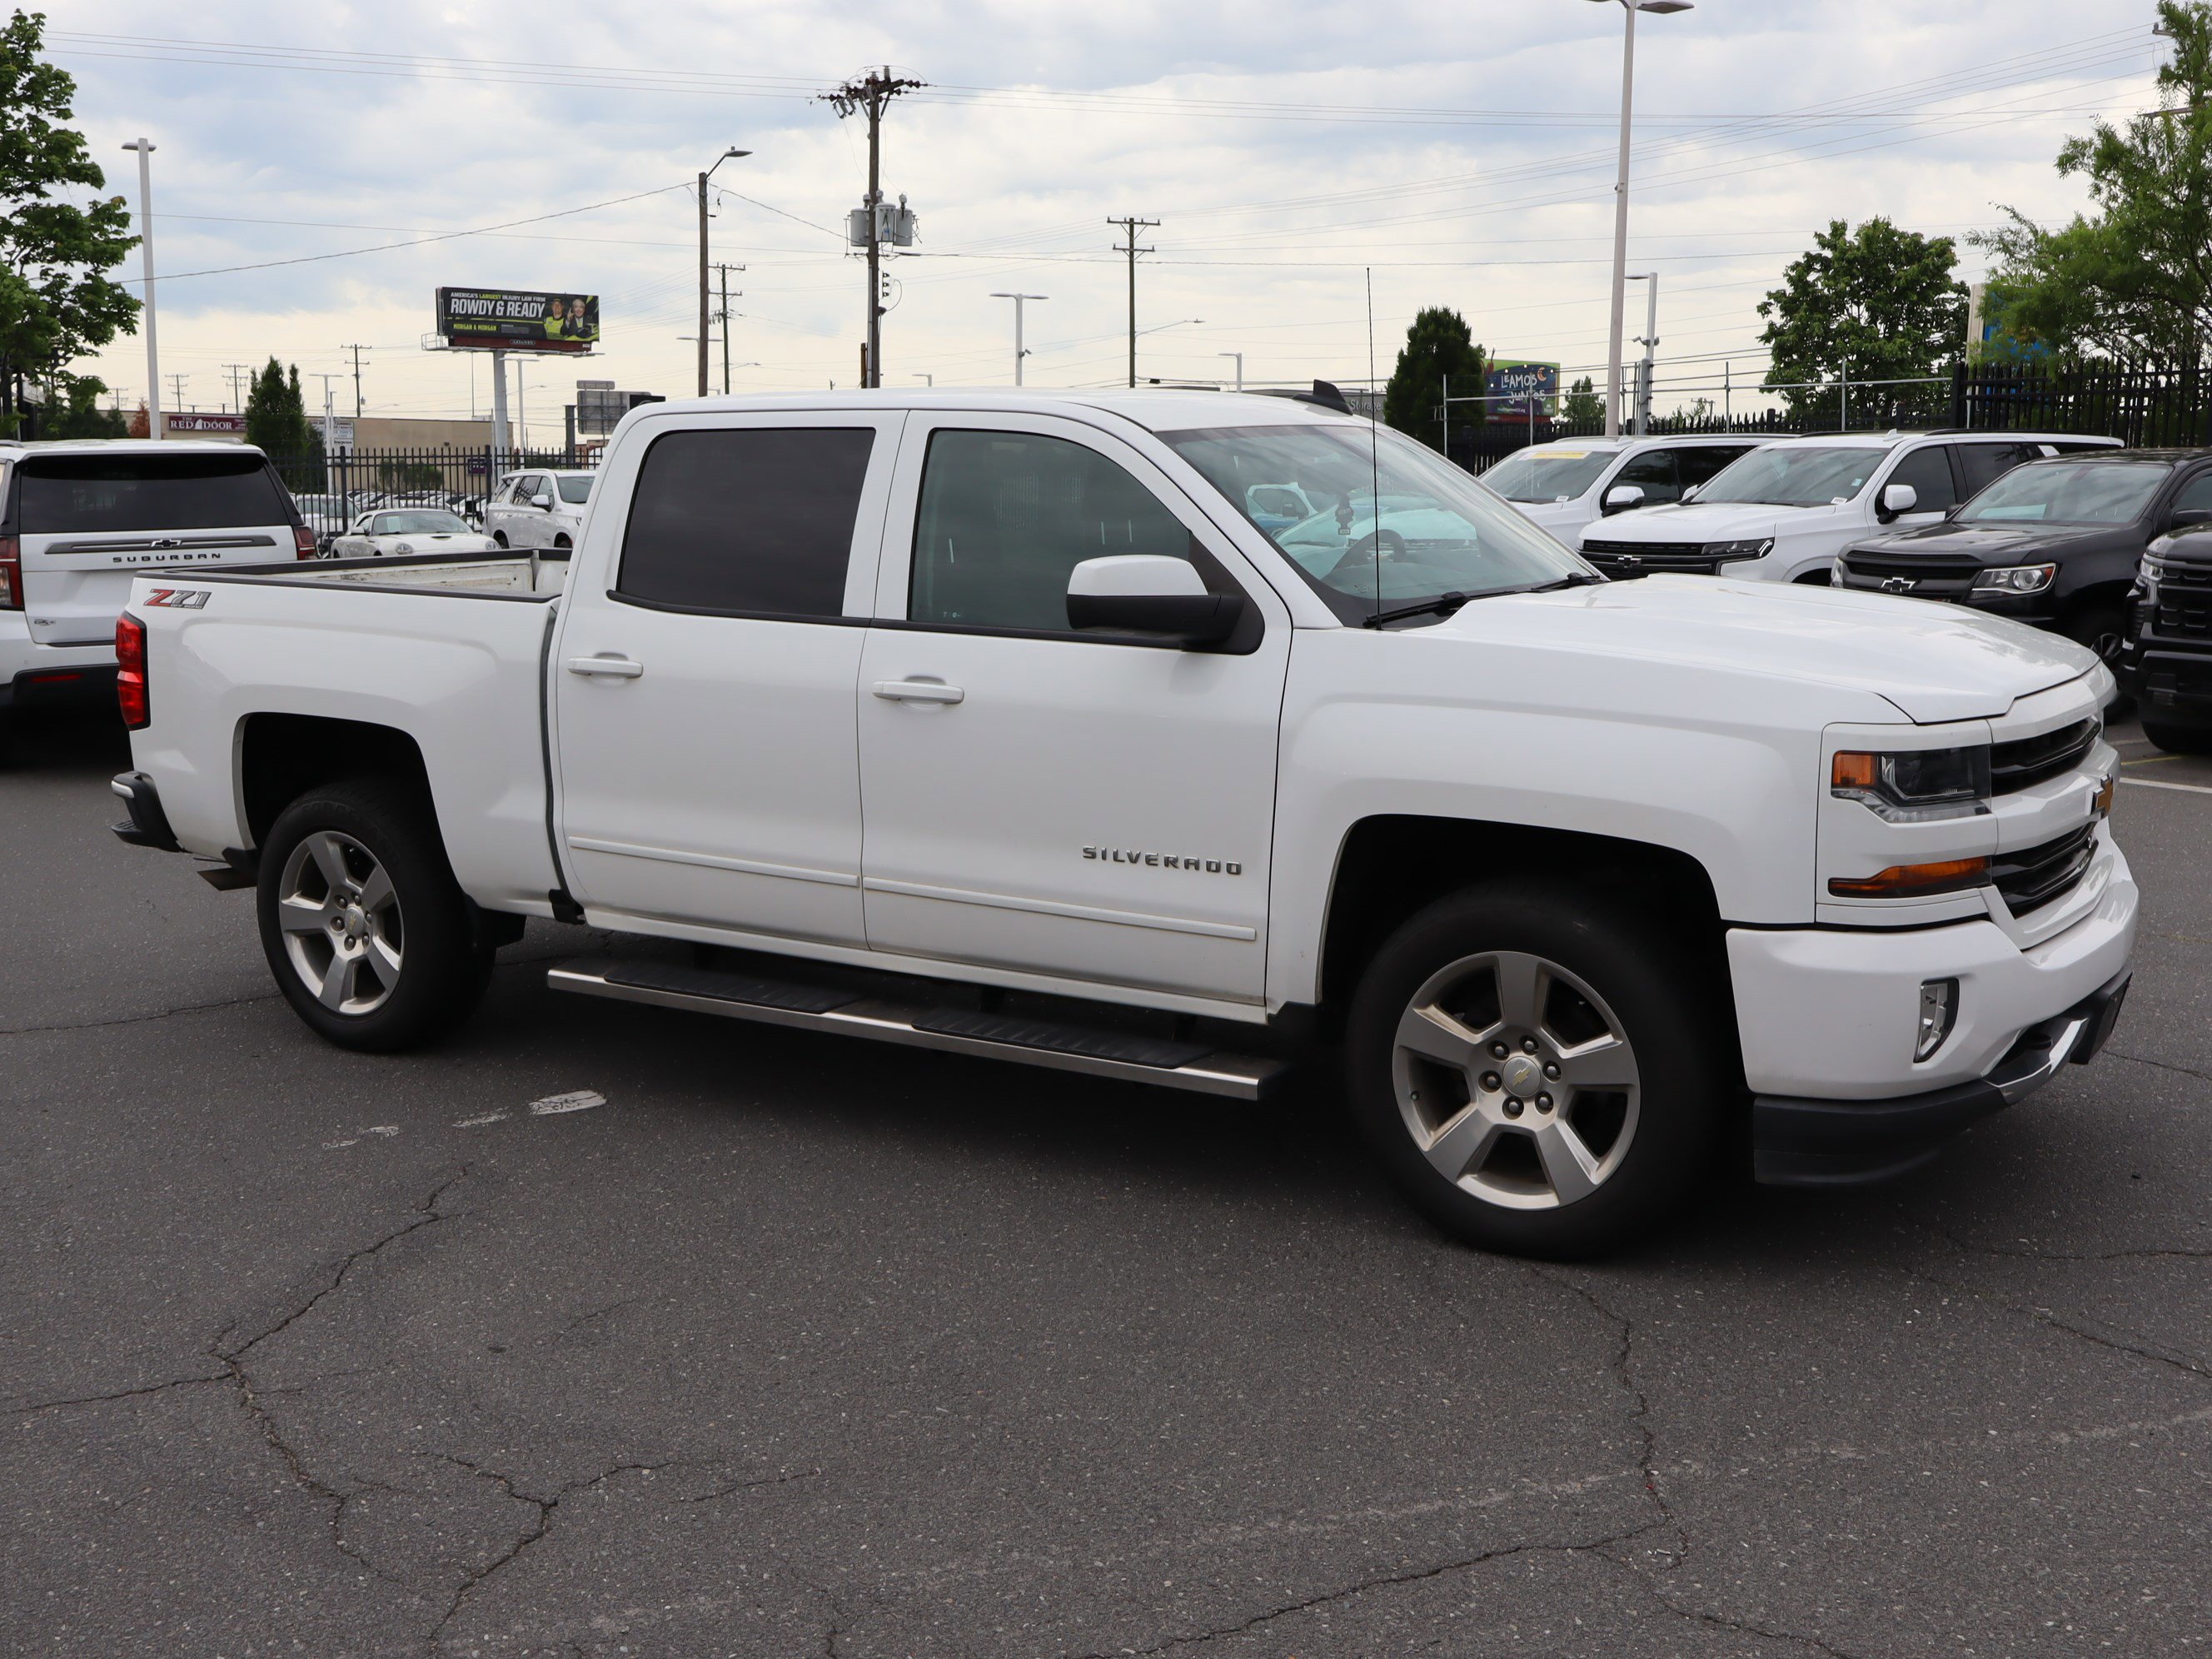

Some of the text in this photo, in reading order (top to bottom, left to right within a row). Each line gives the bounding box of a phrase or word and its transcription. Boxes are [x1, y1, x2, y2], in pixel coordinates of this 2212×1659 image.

[451, 298, 546, 318] ROWDY & READY
[1501, 374, 1537, 388] LEAMOS
[170, 420, 194, 429] RED
[202, 421, 232, 430] DOOR
[112, 552, 222, 564] SUBURBAN
[143, 588, 212, 609] Z71
[1083, 845, 1243, 875] SILVERADO
